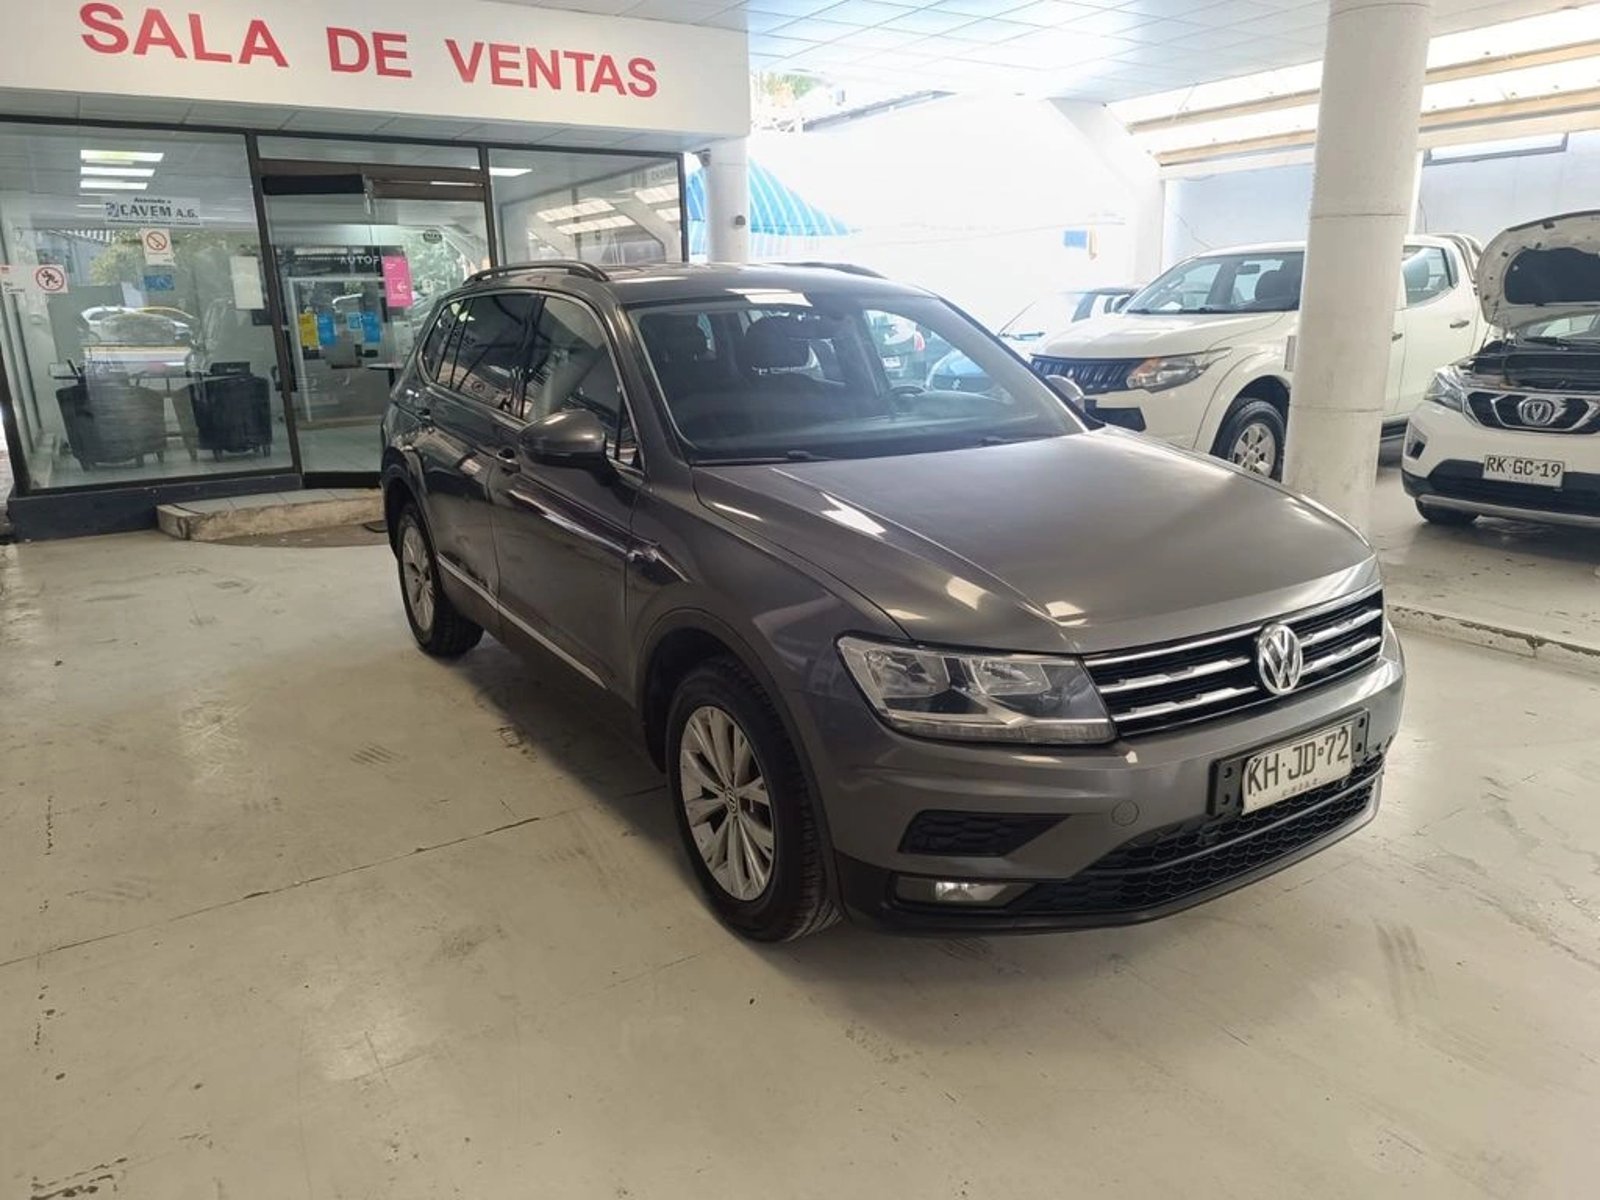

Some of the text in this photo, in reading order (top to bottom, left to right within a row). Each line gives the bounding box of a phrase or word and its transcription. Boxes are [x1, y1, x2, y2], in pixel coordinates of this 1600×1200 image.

[79, 2, 658, 98] SALA DE VENTAS
[120, 204, 172, 217] CAVEM
